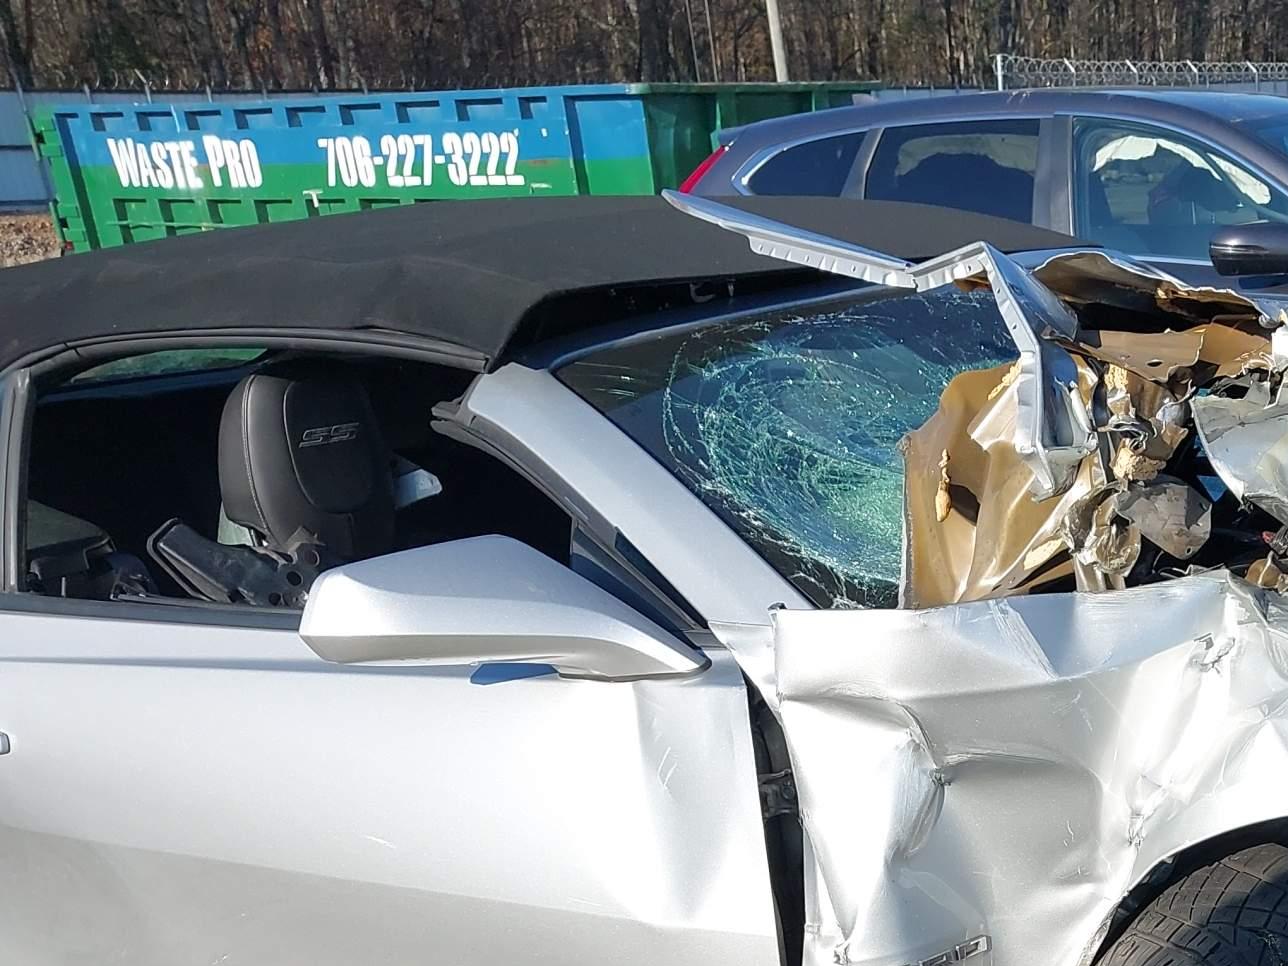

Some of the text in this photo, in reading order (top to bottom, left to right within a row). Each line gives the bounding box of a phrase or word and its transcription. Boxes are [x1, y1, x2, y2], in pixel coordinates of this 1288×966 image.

[107, 134, 263, 190] WASTE PRO
[318, 131, 525, 188] 706-227-3222
[299, 422, 360, 448] SS
